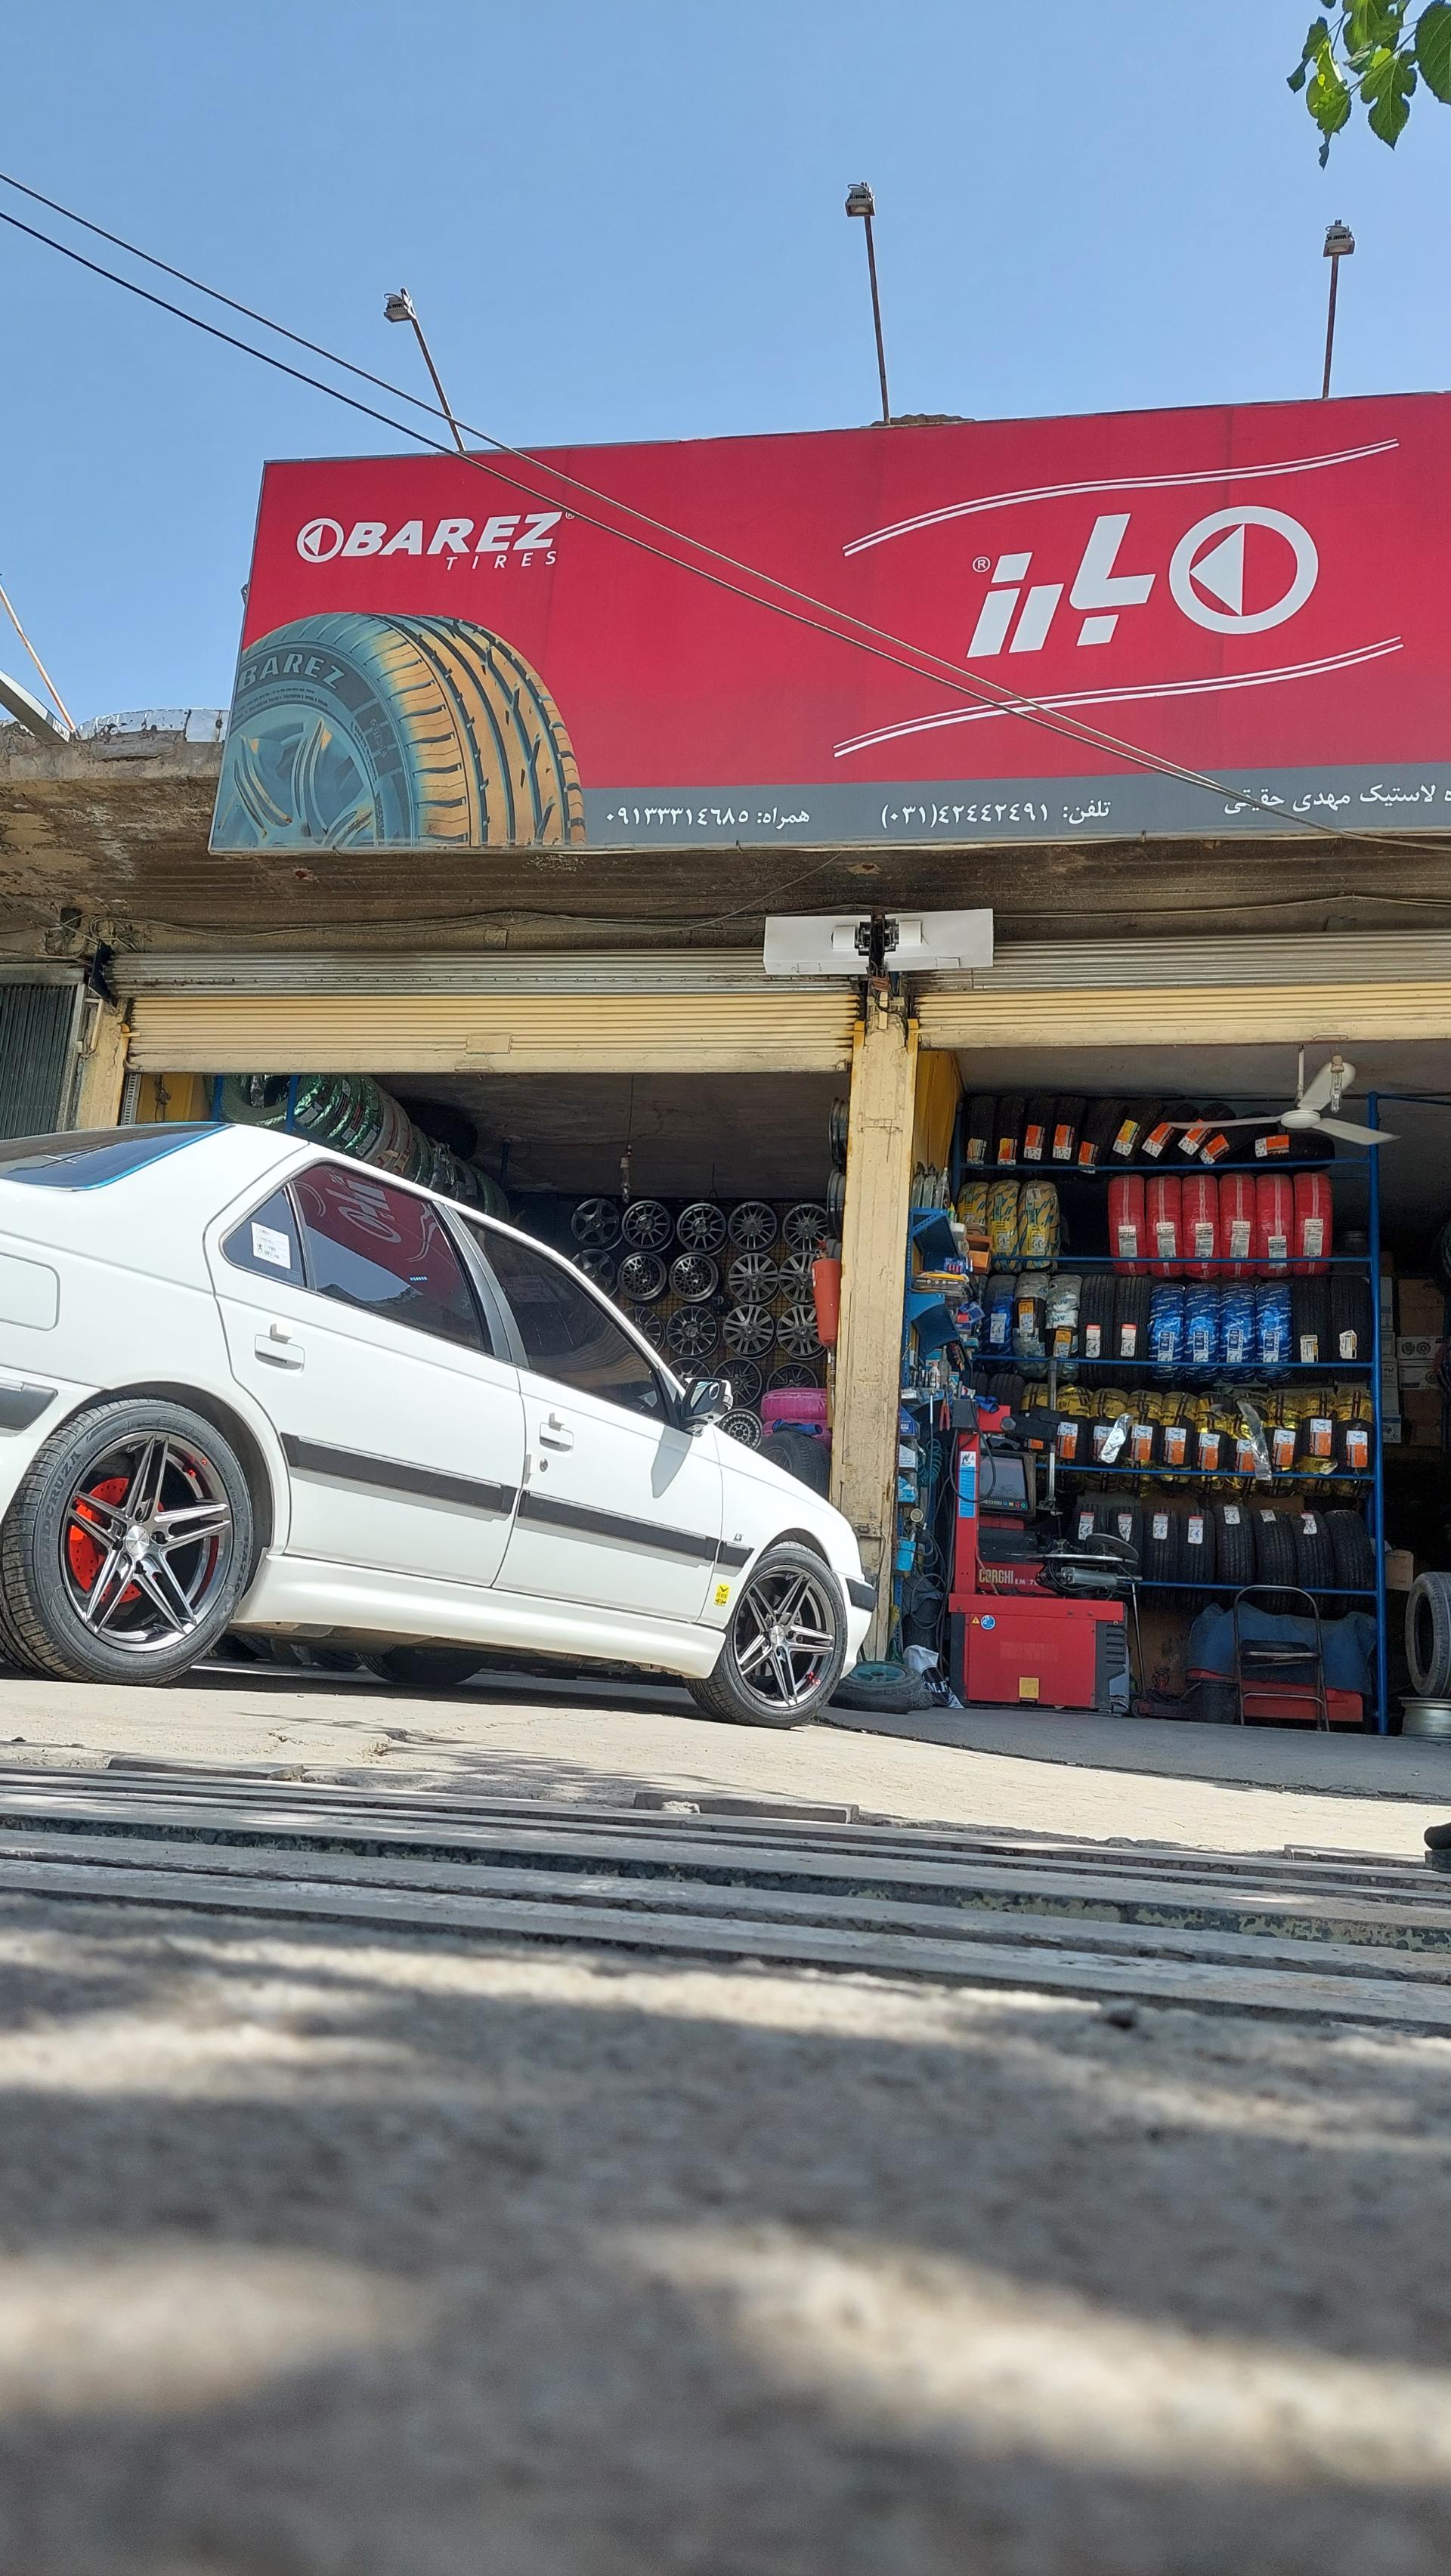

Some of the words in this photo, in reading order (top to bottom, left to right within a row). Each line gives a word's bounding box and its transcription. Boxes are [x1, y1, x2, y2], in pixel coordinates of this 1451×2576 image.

[340, 512, 562, 556] BAREZ
[446, 551, 556, 570] TIRES
[967, 513, 1156, 657] بارز
[237, 653, 345, 692] BAREZ
[1224, 789, 1284, 814] حقیقی
[1293, 792, 1350, 812] مهدی
[1360, 784, 1436, 806] لاستیک
[757, 807, 810, 829] همراه:
[1063, 799, 1111, 824] تلفن:
[979, 1568, 1014, 1585] CORGHI
